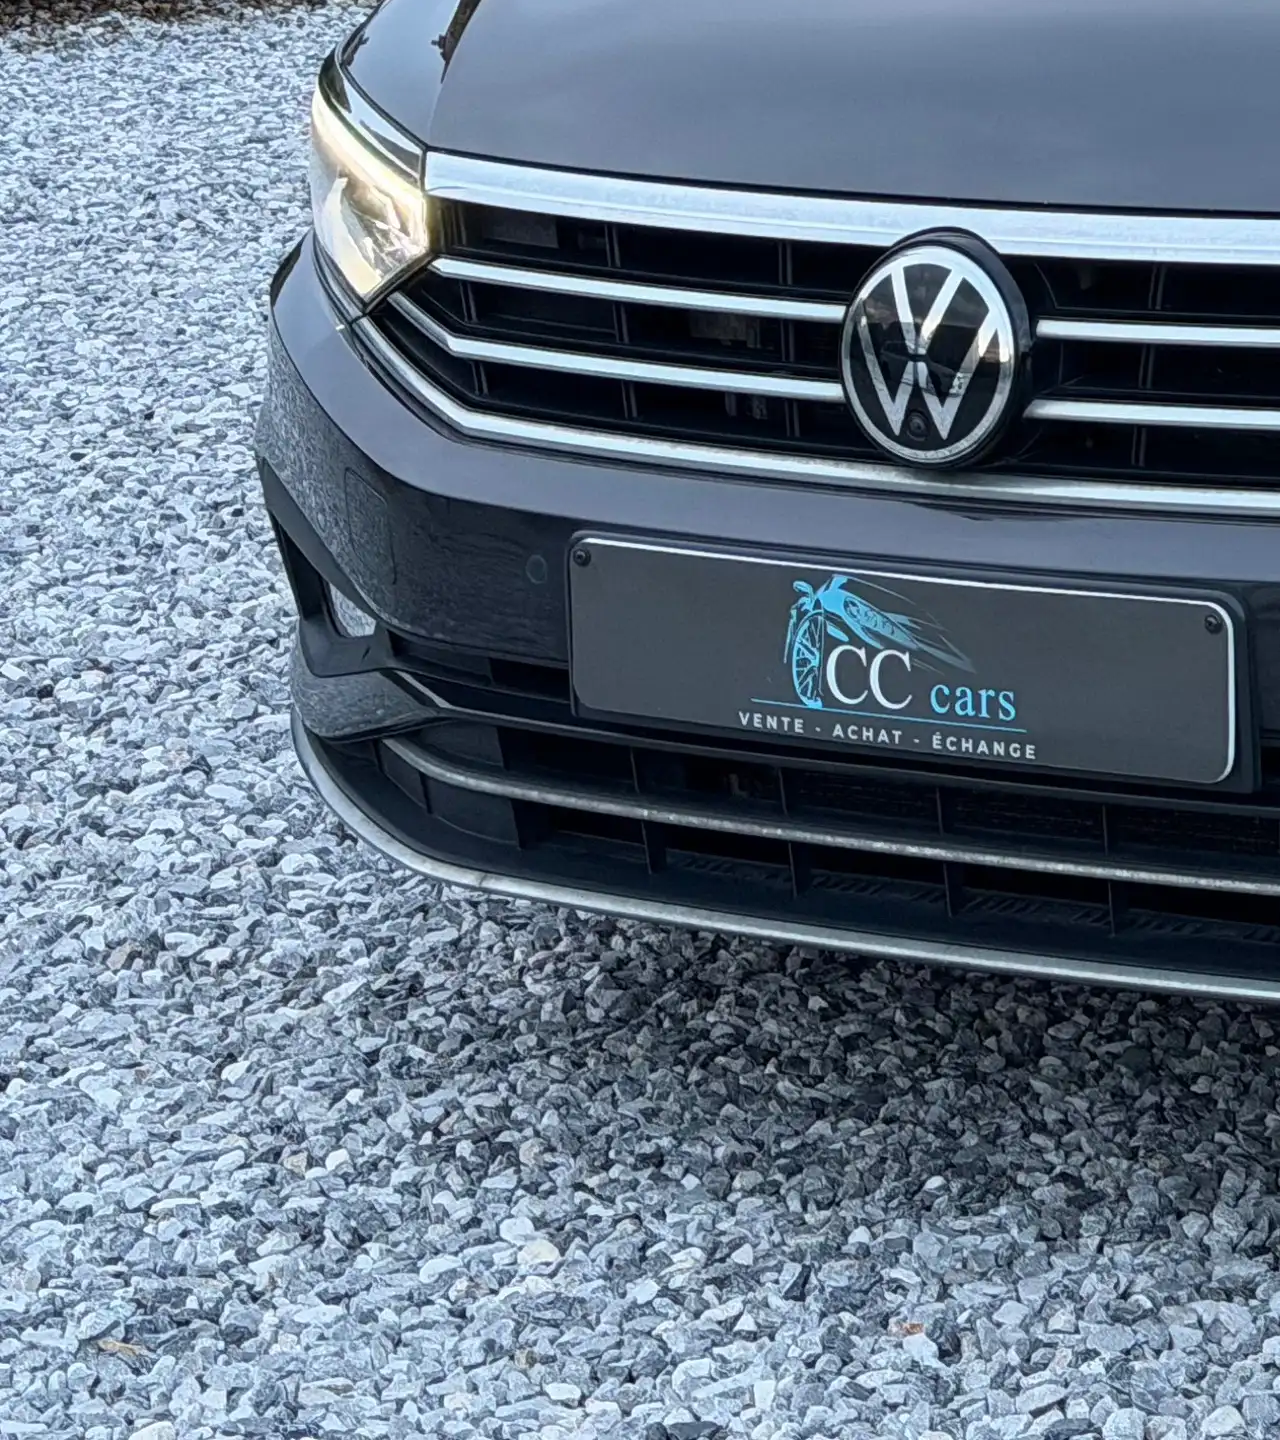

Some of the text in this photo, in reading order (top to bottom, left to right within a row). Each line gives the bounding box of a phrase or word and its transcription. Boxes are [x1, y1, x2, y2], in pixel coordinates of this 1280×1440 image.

[825, 644, 1017, 722] CC cars
[738, 710, 805, 734] VENTE
[831, 722, 903, 745] ACHAT
[931, 731, 1037, 760] ÉCHANGE
